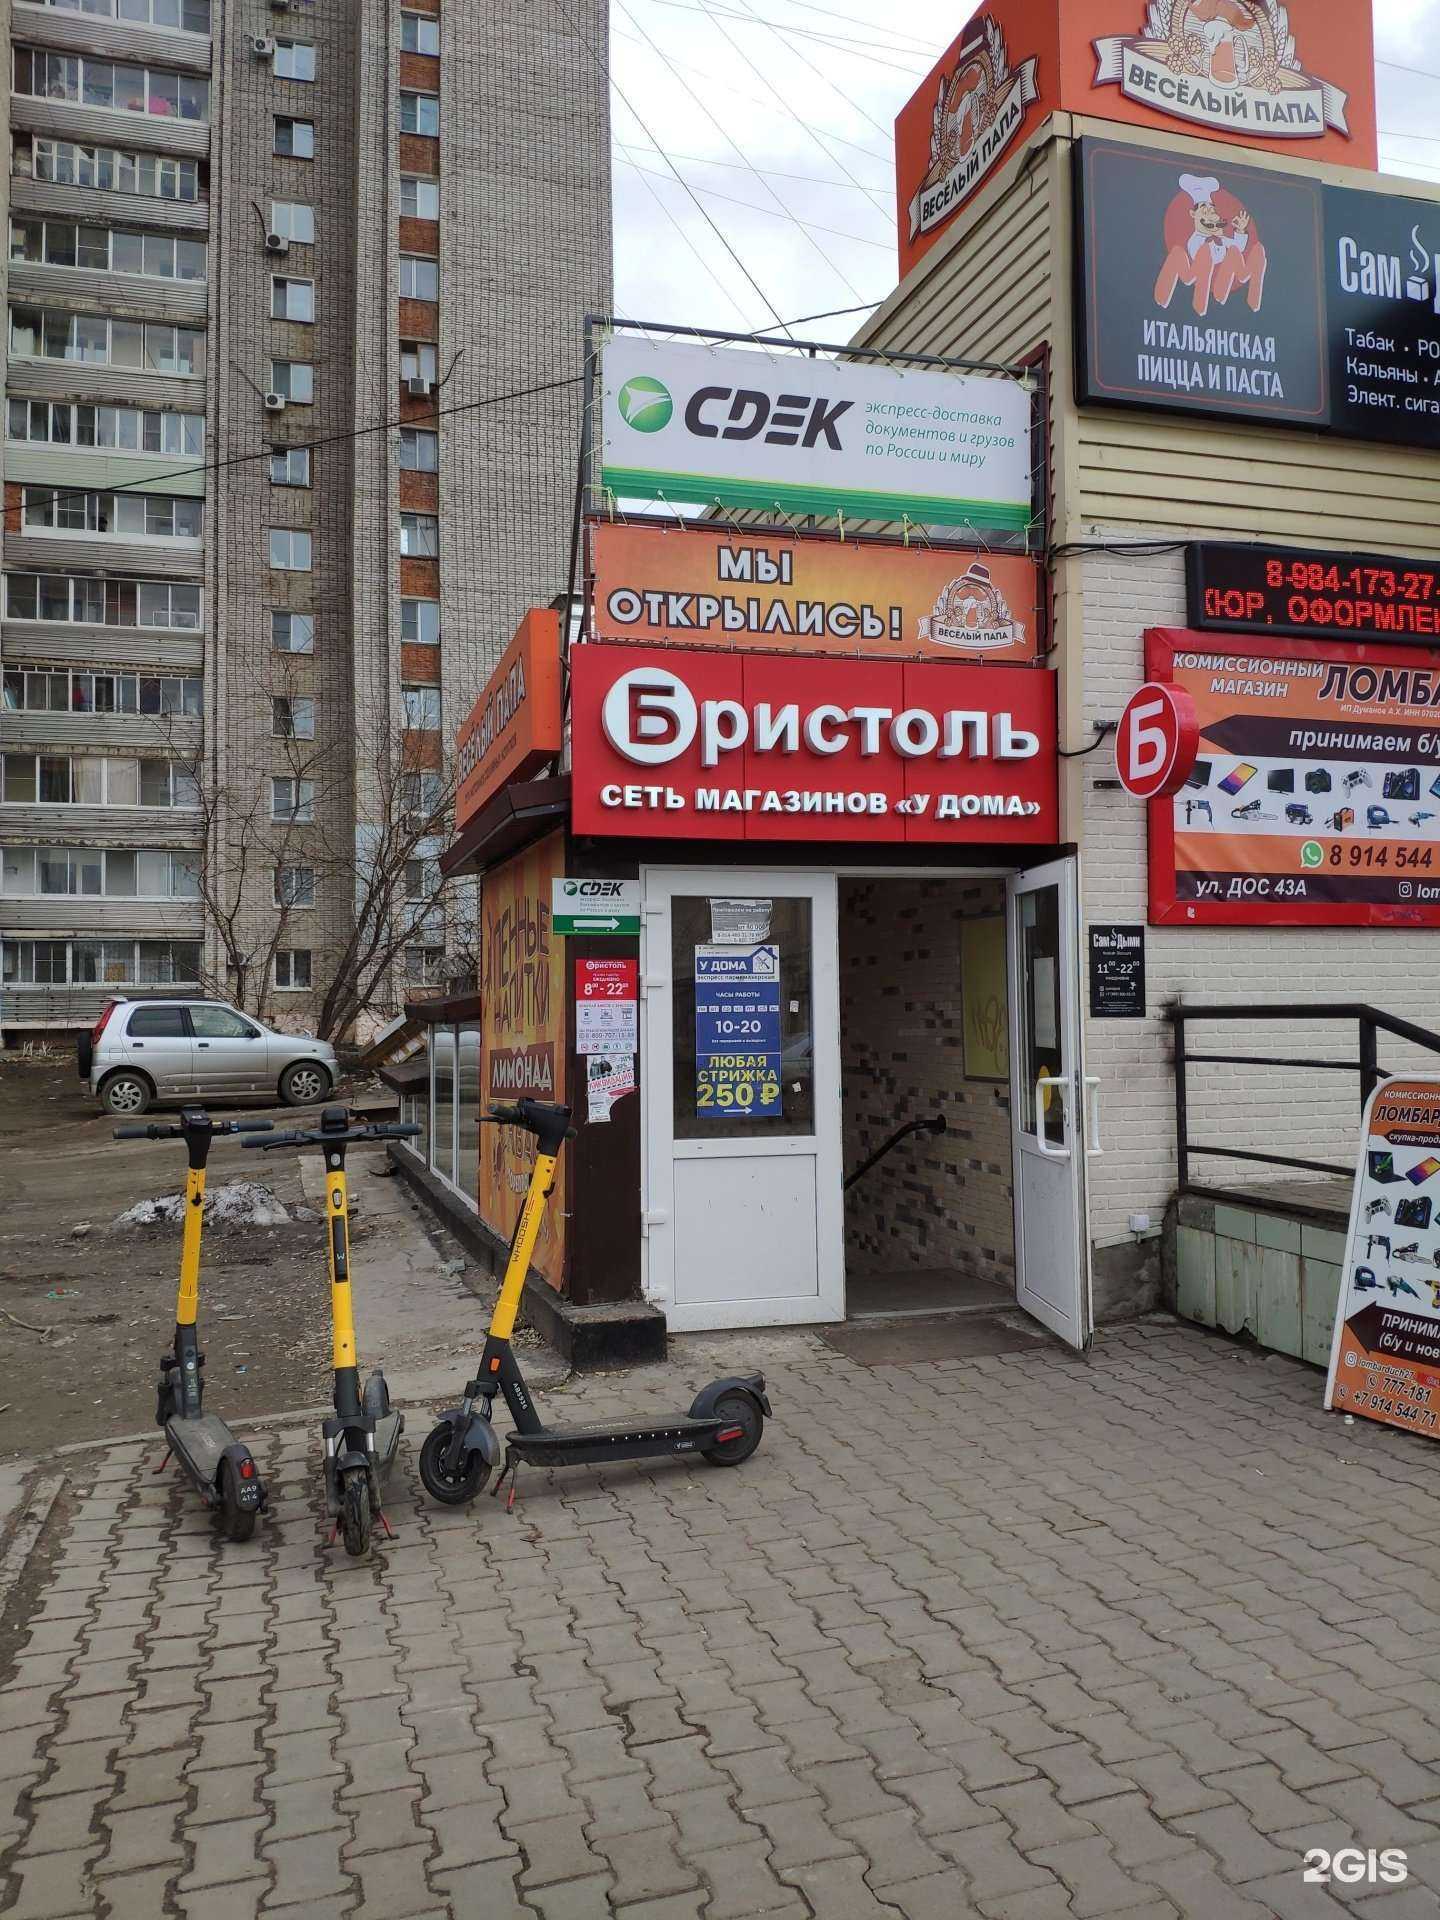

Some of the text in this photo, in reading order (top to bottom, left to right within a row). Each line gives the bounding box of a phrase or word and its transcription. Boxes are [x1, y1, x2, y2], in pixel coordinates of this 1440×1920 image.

[1128, 63, 1320, 123] ВЕСЁЛЫЙ ПАПА
[922, 102, 1020, 222] ВЕСЁЛЫЙ ПАПА
[1338, 236, 1402, 299] Сам
[1143, 319, 1275, 362] ИТАЛЬЯНСКАЯ
[1345, 327, 1396, 352] Табак
[1137, 354, 1284, 398] ПИЦЦА И ПАСТА
[1346, 356, 1418, 383] Кальяны
[1347, 385, 1440, 414] Элект. сига
[684, 385, 856, 452] CDEK
[865, 402, 1003, 427] экспресс-доставка
[865, 420, 1015, 448] документов и грузов
[865, 443, 986, 468] по России и миру
[716, 544, 794, 586] МЫ
[607, 586, 904, 642] ОТКРЫЛИСЬ!
[983, 632, 1008, 641] ПАПА
[1173, 652, 1324, 678] КОМИССИОННЫЙ
[495, 652, 526, 738] ПАПА
[1210, 678, 1289, 698] МАГАЗИН
[602, 667, 1040, 768] Бристоль
[1129, 699, 1167, 780] Б
[1289, 730, 1412, 753] принимаем
[601, 785, 1041, 820] СЕТЬ МАГАЗИНОВ «У ДОМА»
[1329, 844, 1432, 868] 8 914 544
[579, 882, 625, 897] CDEK
[1196, 877, 1307, 898] ул. ДОС 43А
[1093, 933, 1110, 948] Сам
[586, 960, 627, 970] Бристоль
[699, 960, 747, 973] У ДОМА
[715, 1020, 762, 1034] 10-20
[492, 1053, 552, 1092] ЛИМОНАД
[709, 1055, 768, 1068] ЛЮБАЯ
[697, 1069, 778, 1083] СТРИЖКА
[696, 1082, 754, 1107] 250
[1389, 1133, 1440, 1144] скупка-прод
[1379, 1332, 1403, 1352] (б/у
[1405, 1342, 1414, 1352] и
[1382, 1377, 1433, 1403] 777-181
[1354, 1391, 1437, 1427] +7 914 544 71
